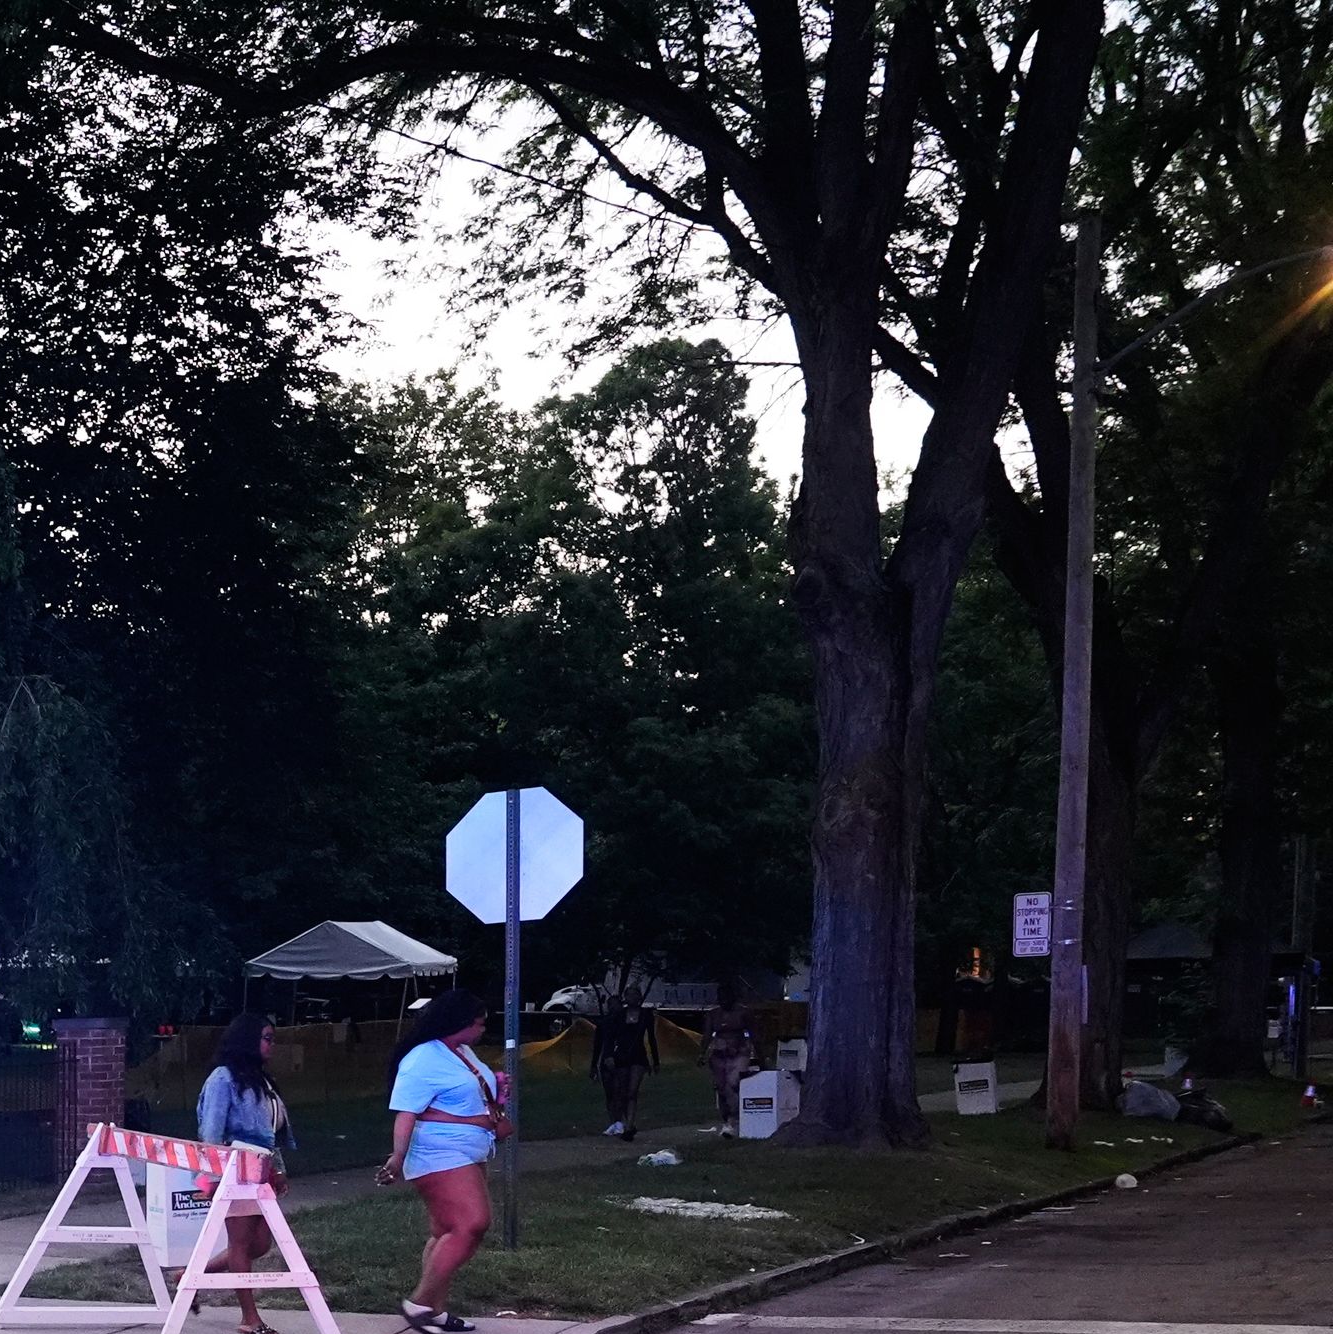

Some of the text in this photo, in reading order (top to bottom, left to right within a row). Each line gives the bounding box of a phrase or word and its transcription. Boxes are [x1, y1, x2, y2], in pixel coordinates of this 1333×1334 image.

[1026, 897, 1039, 906] NO
[1016, 907, 1048, 917] STOPPING
[1024, 917, 1041, 926] ANY
[1023, 926, 1042, 936] TIME
[174, 1193, 190, 1202] The
[174, 1199, 213, 1210] Anderso
